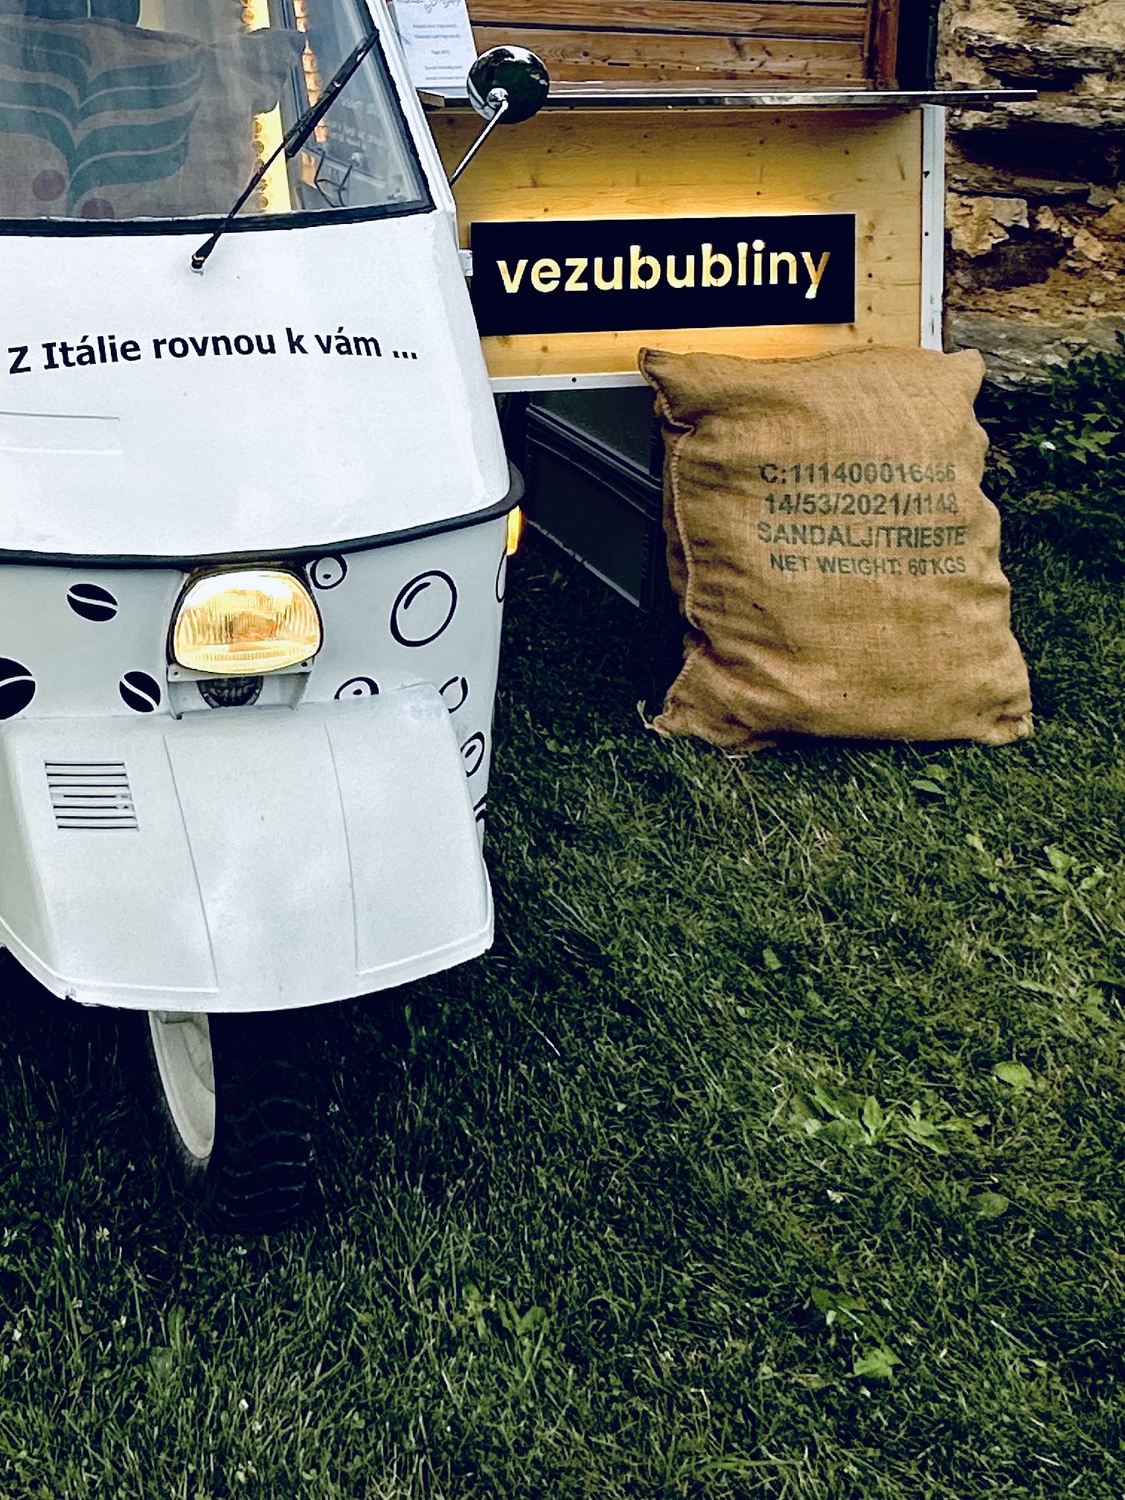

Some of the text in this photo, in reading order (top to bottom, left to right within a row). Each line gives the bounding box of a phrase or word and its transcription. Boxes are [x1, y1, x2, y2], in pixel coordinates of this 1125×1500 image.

[496, 239, 831, 299] vezububliny
[8, 346, 32, 374] Z
[42, 334, 142, 371] Itálie
[153, 333, 276, 359] rovnou
[286, 327, 309, 355] k
[314, 326, 383, 358] vám
[770, 553, 810, 573] NET
